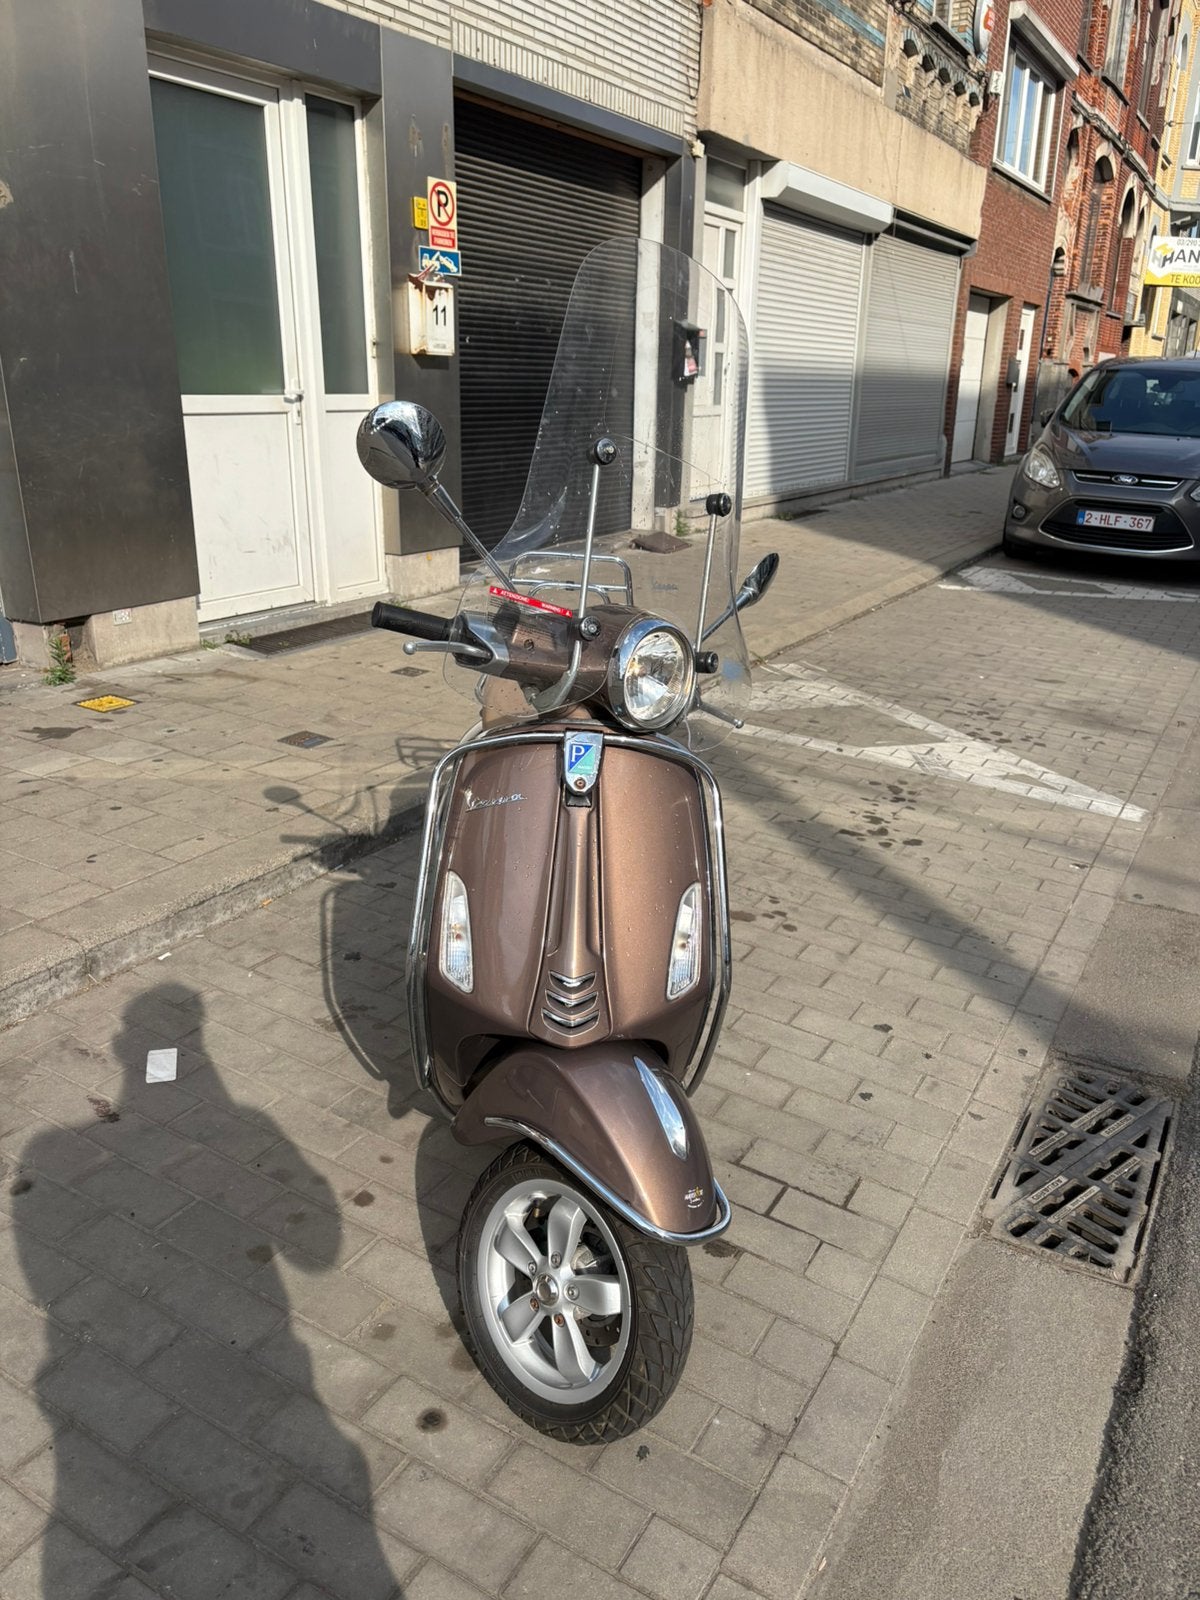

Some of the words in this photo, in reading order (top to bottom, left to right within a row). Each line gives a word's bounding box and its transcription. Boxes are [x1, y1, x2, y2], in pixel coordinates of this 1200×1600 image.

[437, 190, 449, 218] P
[1170, 274, 1182, 284] TE
[432, 304, 447, 327] 11
[571, 745, 585, 762] P
